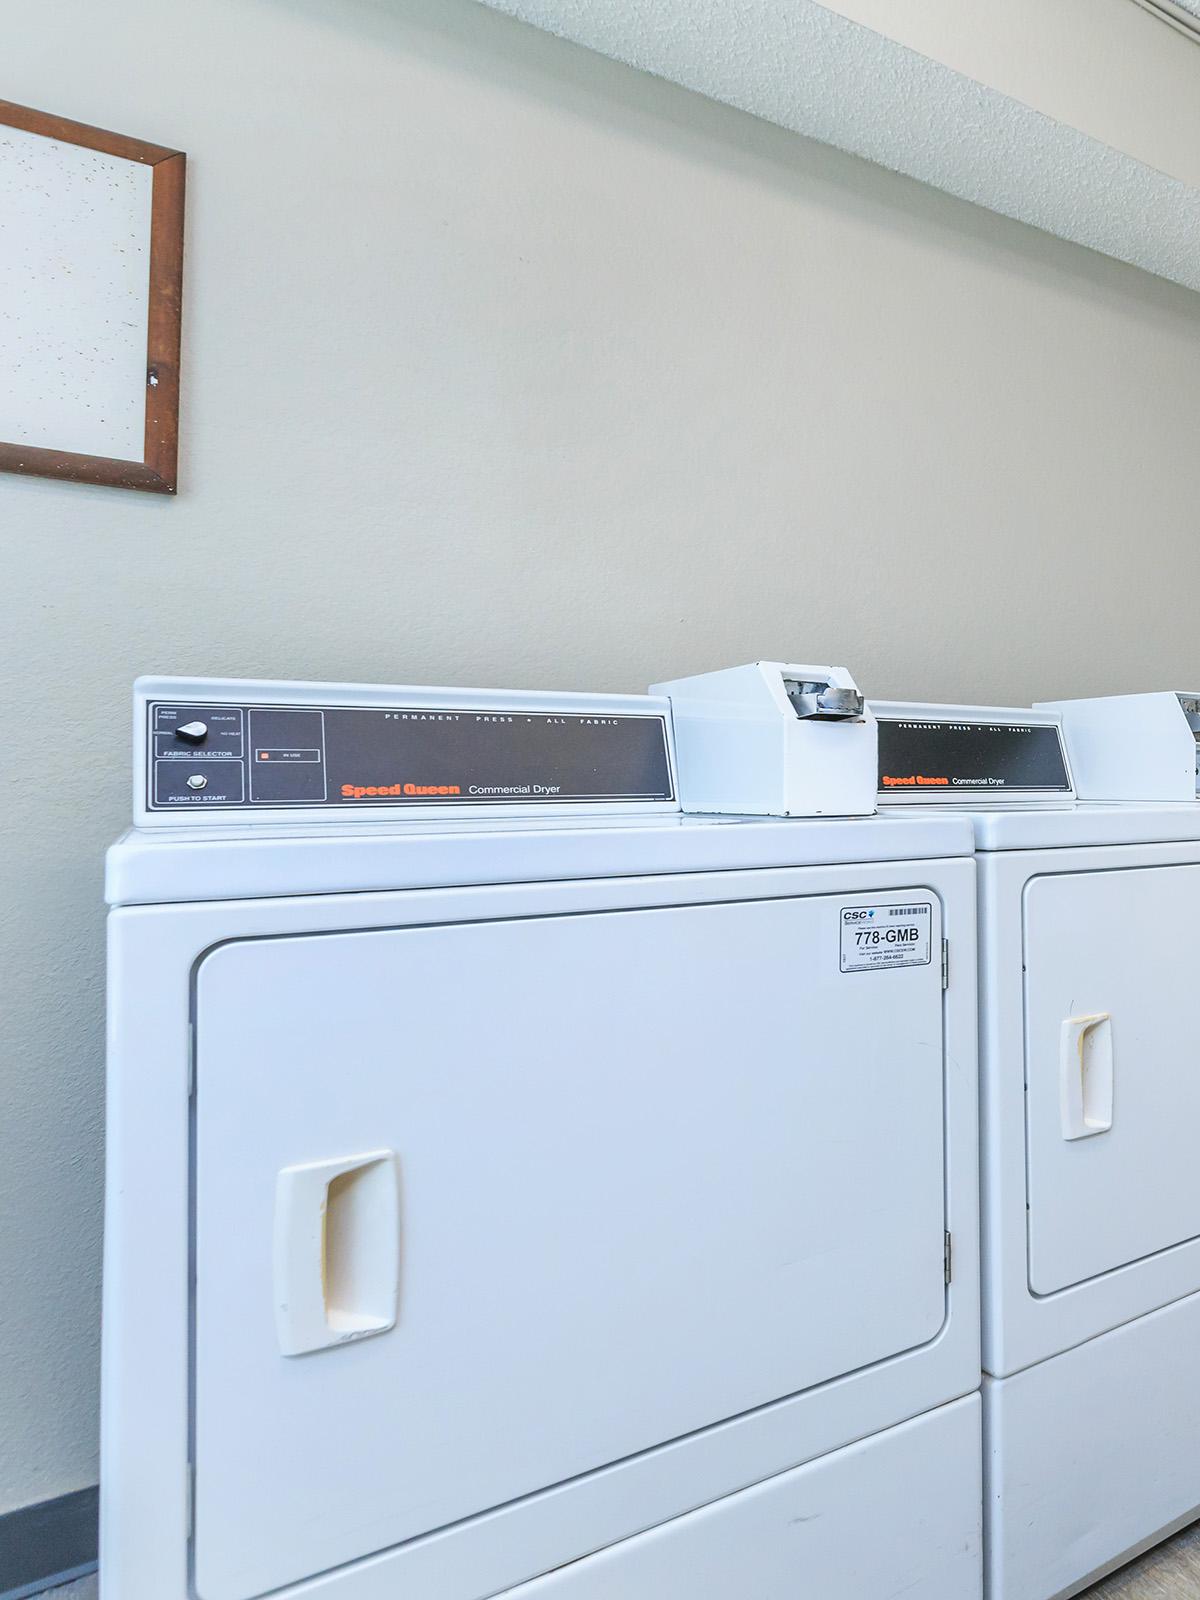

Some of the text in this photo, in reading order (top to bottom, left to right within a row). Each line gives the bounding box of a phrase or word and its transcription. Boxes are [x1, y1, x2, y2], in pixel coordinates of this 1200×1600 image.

[385, 713, 461, 721] PERMANENT
[882, 776, 1005, 786] Speed Queen Commercial Dryer
[341, 783, 561, 798] Speed Queen Commercial Dryer
[844, 911, 867, 920] CSC
[855, 928, 919, 945] 778-GMB
